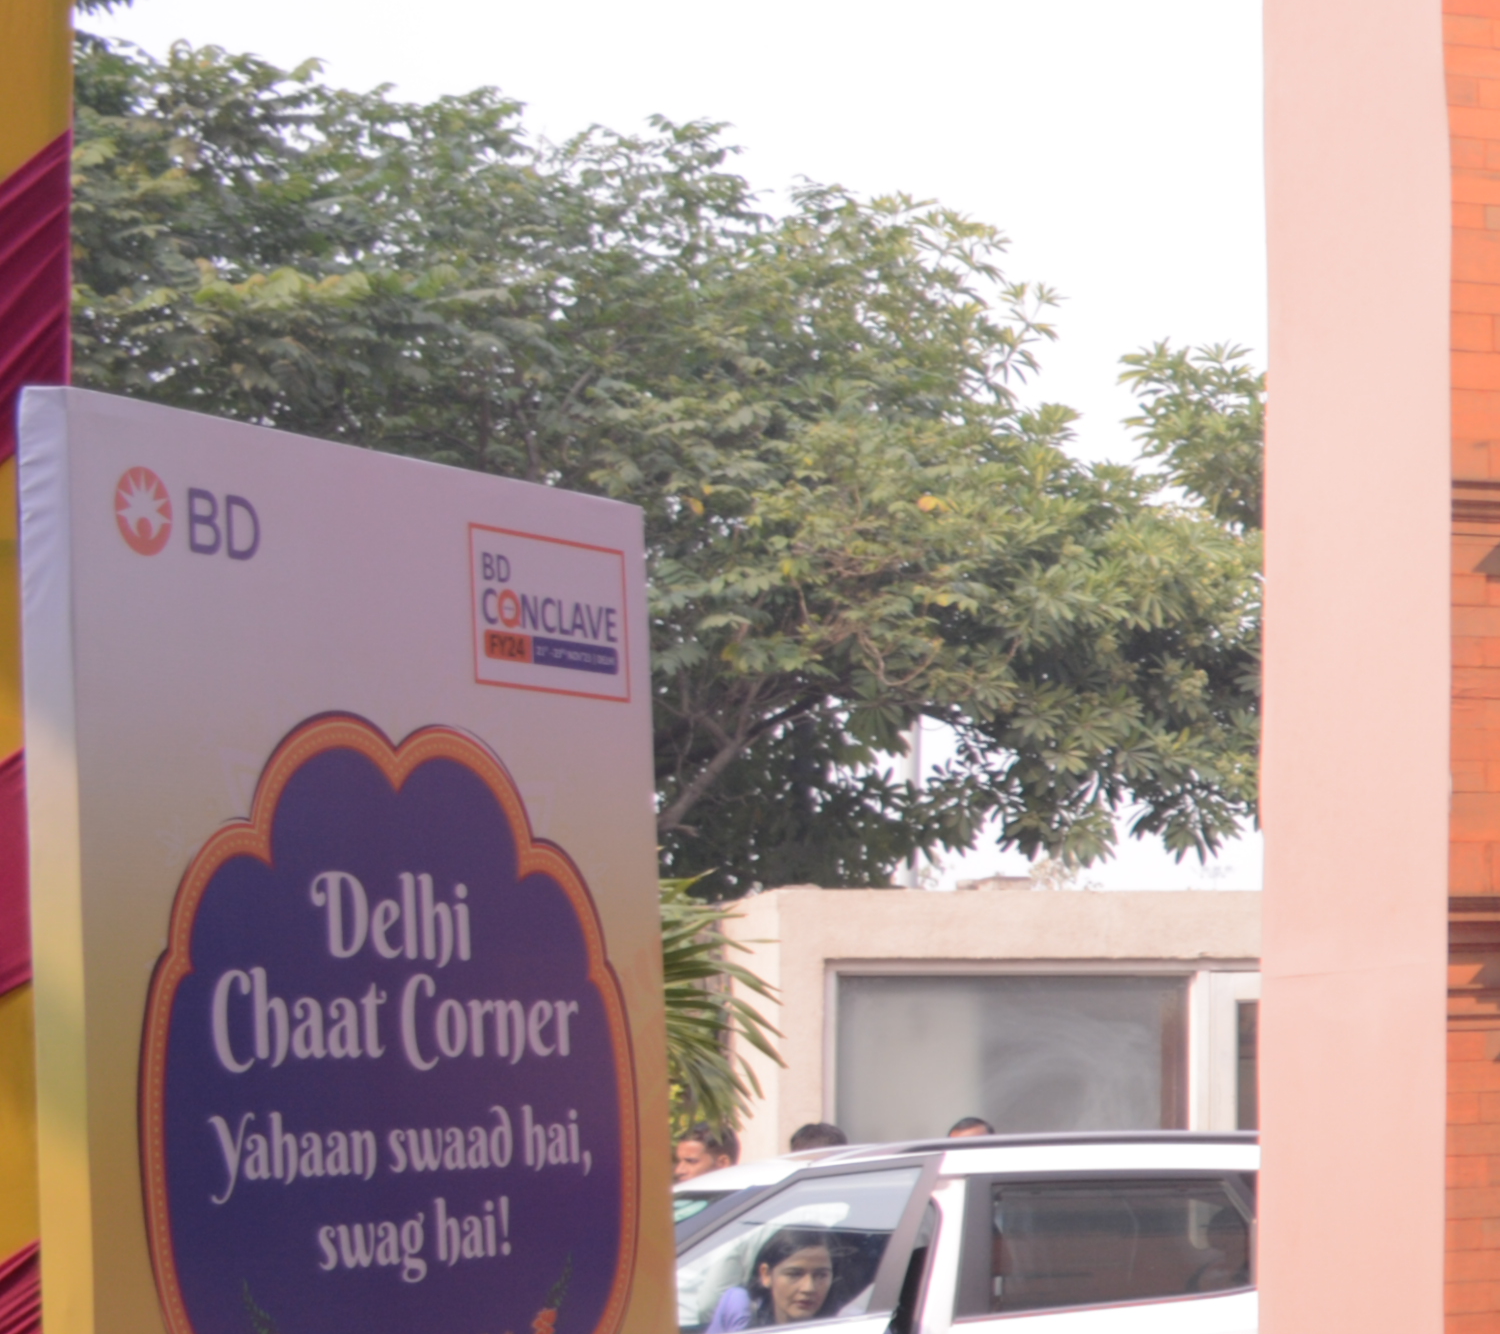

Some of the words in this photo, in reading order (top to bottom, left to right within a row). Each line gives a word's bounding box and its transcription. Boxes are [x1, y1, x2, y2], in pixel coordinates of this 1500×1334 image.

[188, 487, 261, 561] BD
[482, 552, 511, 583] BD
[482, 588, 618, 643] CONCLAVE
[488, 634, 526, 658] FY24
[310, 870, 471, 968] Delhi
[212, 966, 388, 1073] Chaat
[401, 973, 579, 1071] Corner
[208, 1111, 377, 1205] Yahaan
[388, 1104, 513, 1173] swaad
[521, 1104, 592, 1177] hai,
[318, 1212, 428, 1284] swag
[434, 1195, 512, 1267] hai!
